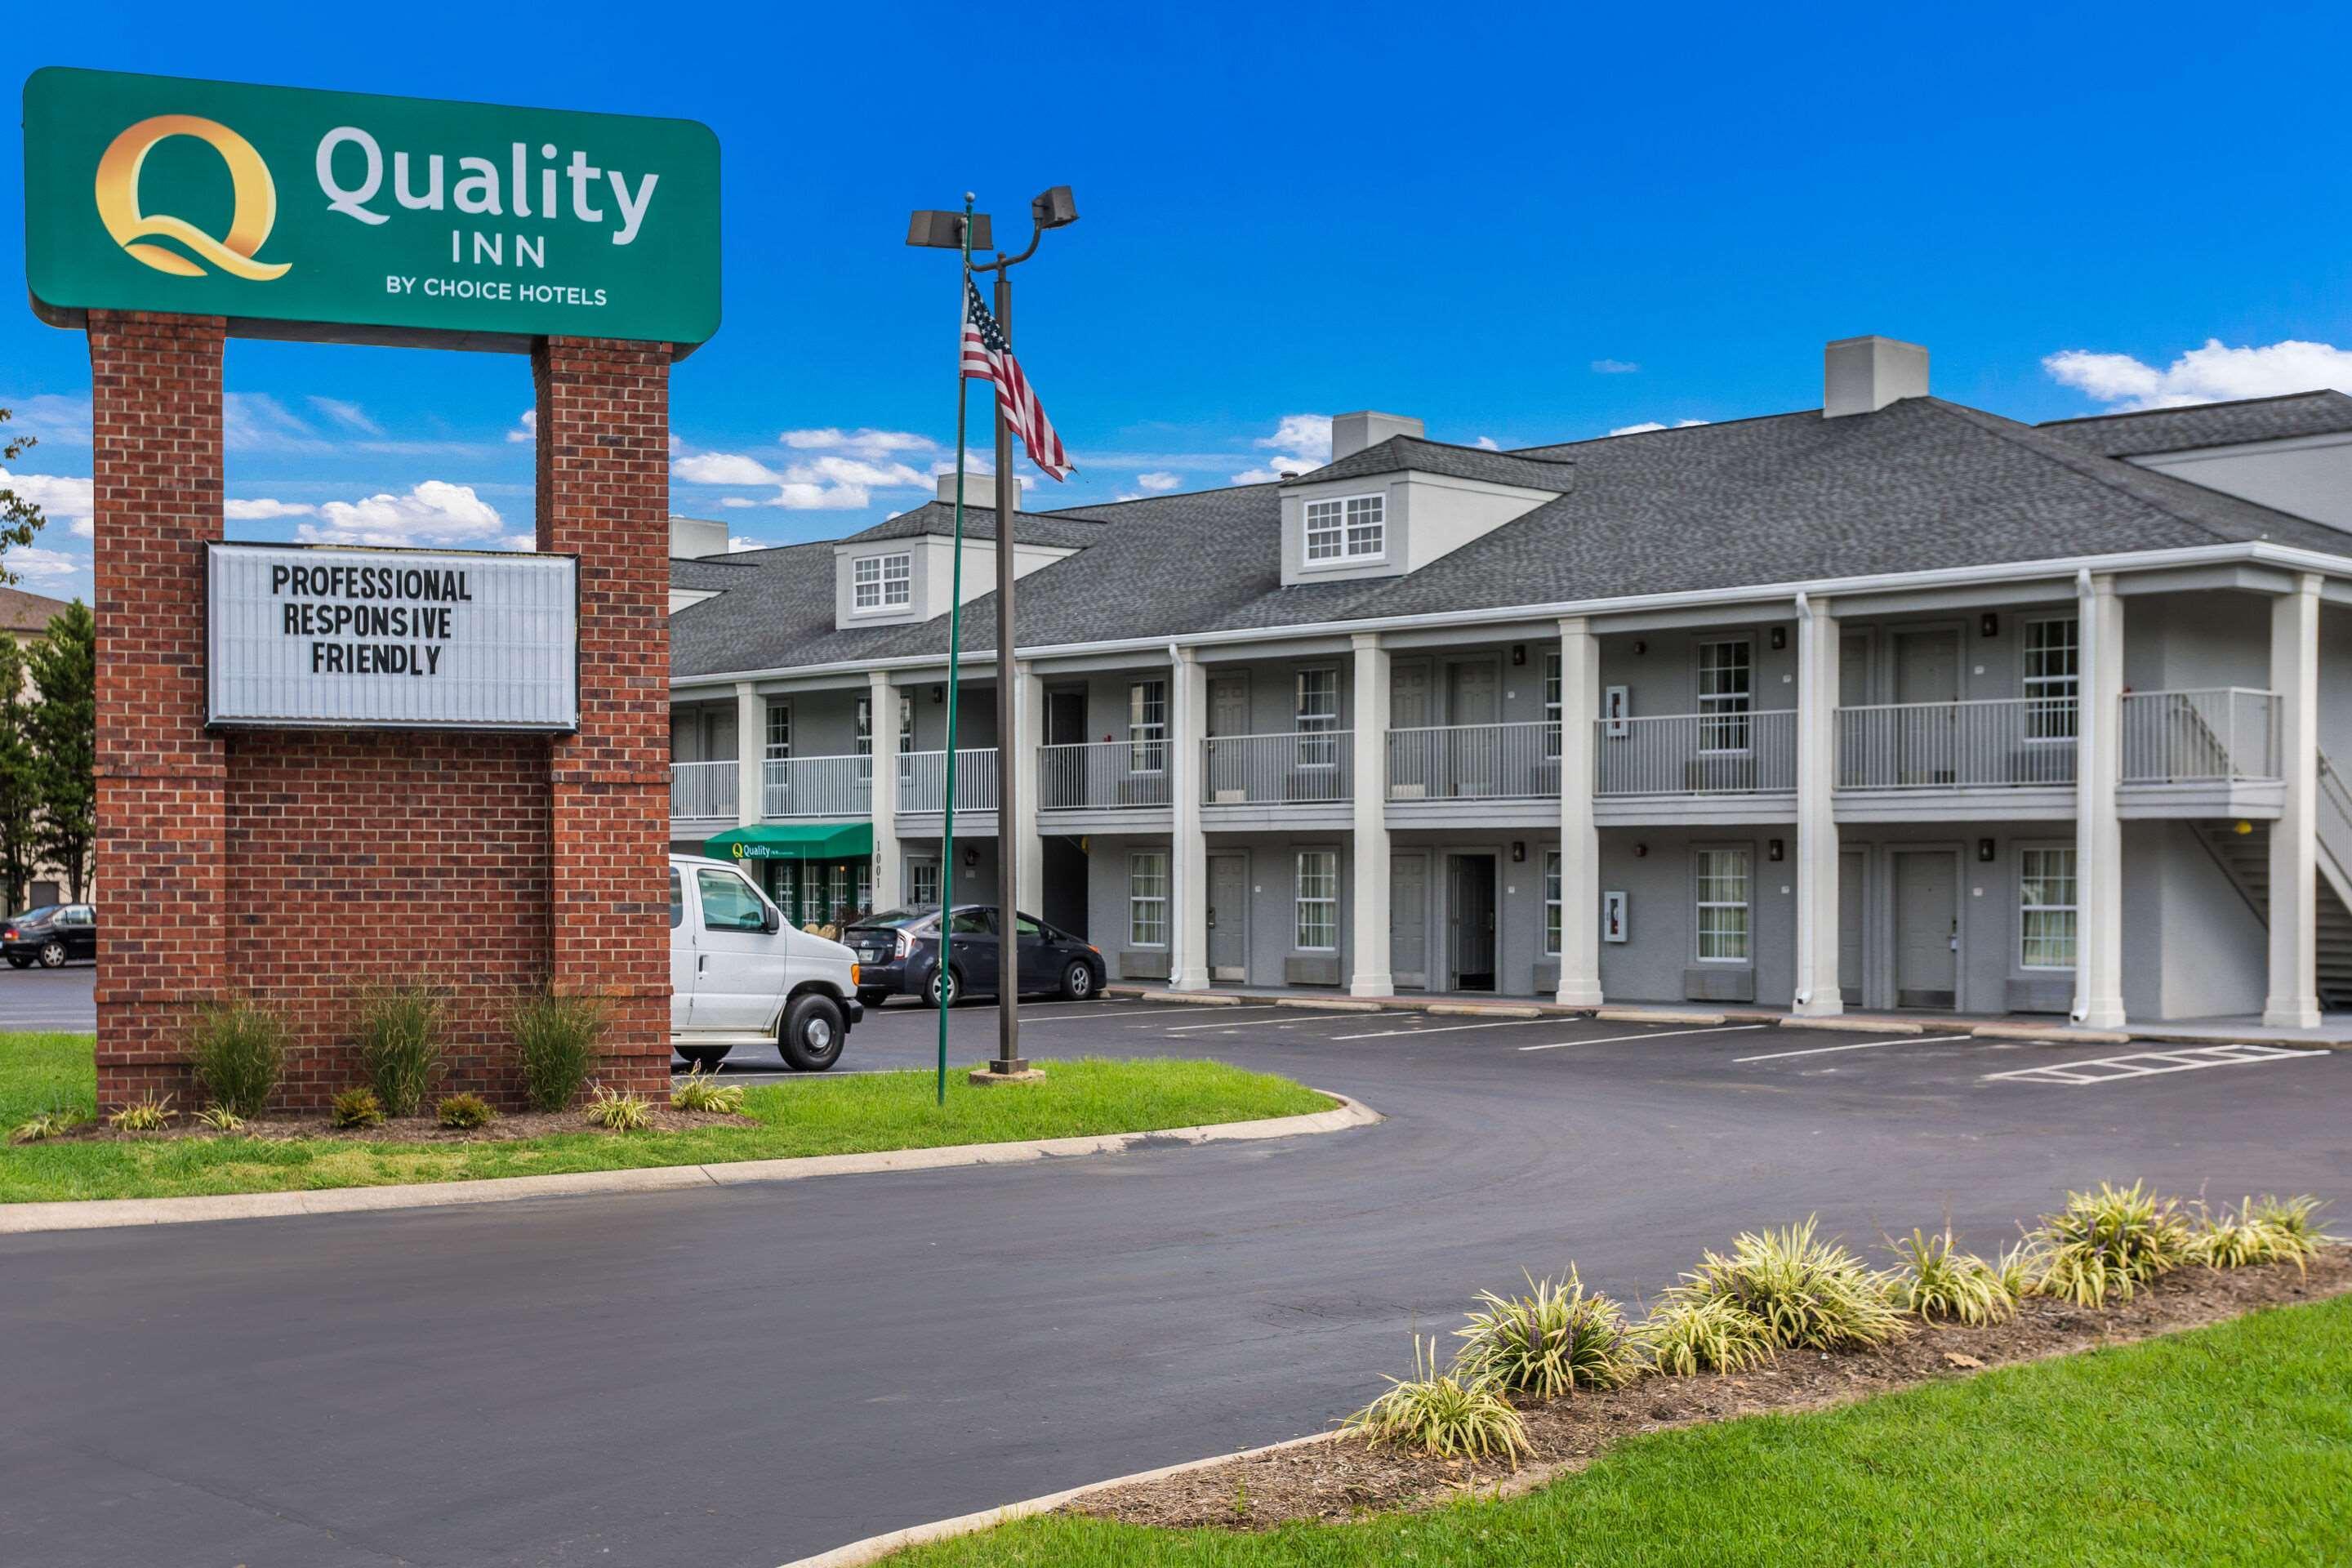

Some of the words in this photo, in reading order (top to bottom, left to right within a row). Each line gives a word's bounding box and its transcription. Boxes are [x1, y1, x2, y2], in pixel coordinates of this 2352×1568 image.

[315, 127, 659, 245] Quality
[452, 229, 545, 268] INN
[386, 275, 416, 294] BY
[424, 278, 511, 301] CHOICE
[519, 284, 607, 306] HOTELS
[272, 564, 472, 602] PROFESSIONAL
[283, 603, 452, 639] RESPONSIVE
[312, 641, 442, 675] FRIENDLY
[744, 844, 770, 858] Quality
